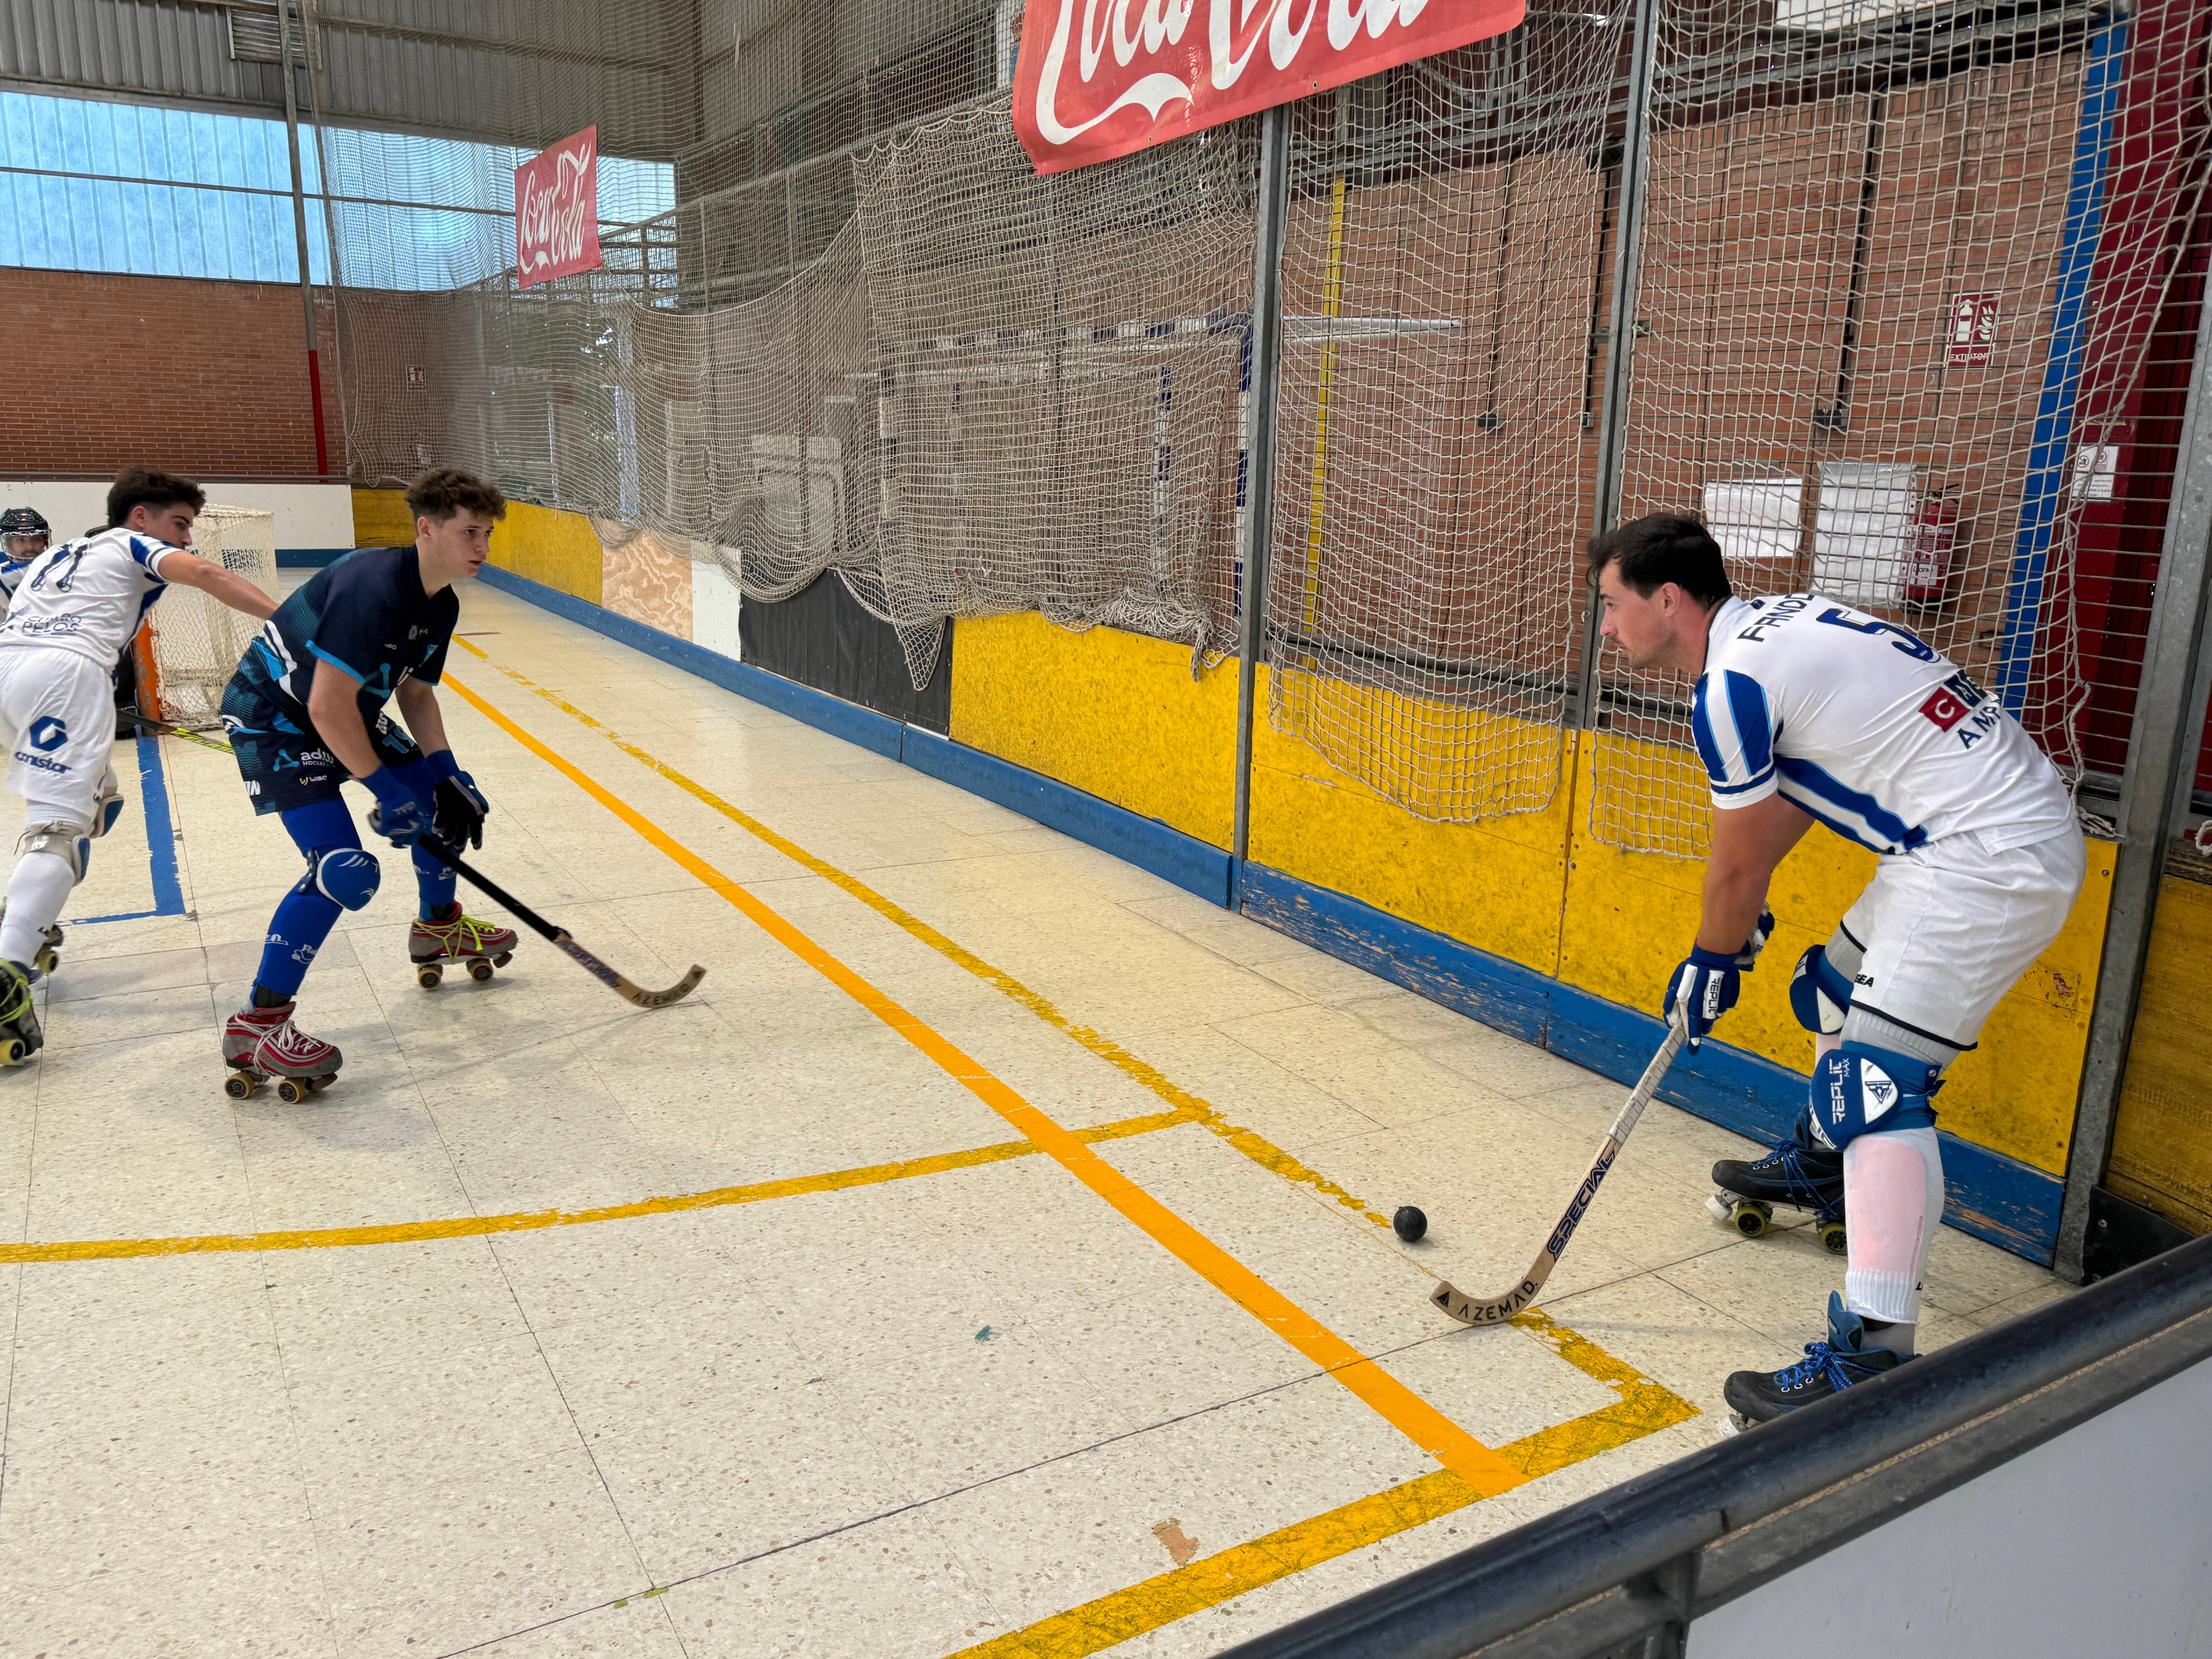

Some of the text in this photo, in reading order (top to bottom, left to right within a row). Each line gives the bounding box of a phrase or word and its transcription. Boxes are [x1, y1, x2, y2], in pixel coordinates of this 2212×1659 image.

[1816, 608, 1941, 663] 5
[1829, 1058, 1846, 1125] REPLIC
[1842, 1058, 1850, 1077] MAX
[1547, 1149, 1615, 1263] SPECIAL
[1458, 1280, 1536, 1321] AZEMAD
